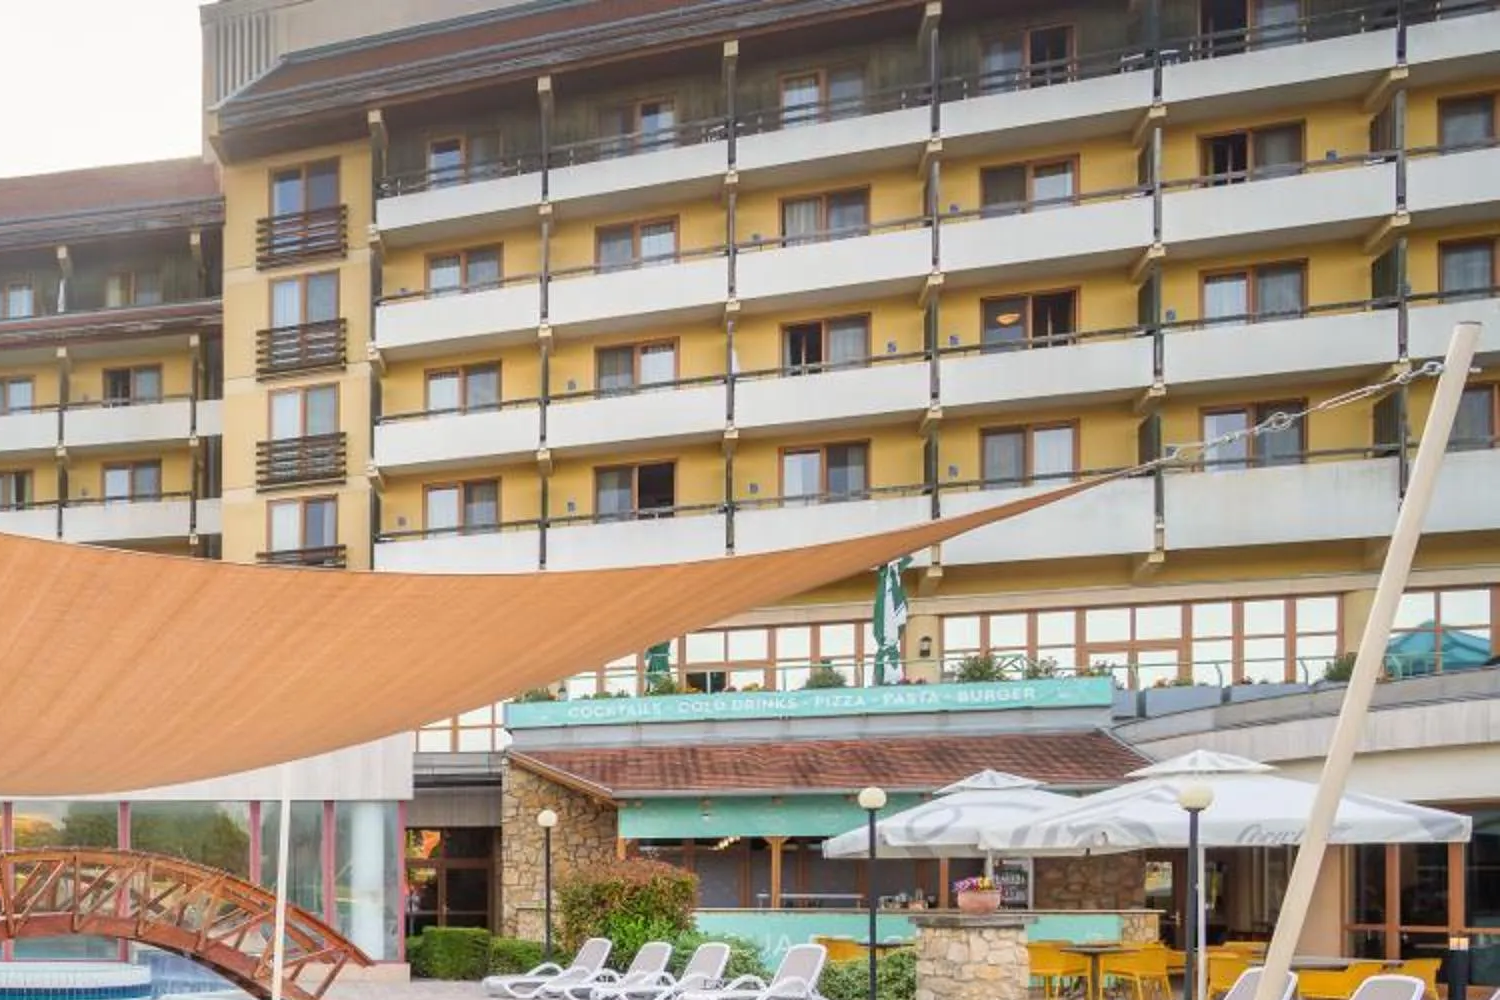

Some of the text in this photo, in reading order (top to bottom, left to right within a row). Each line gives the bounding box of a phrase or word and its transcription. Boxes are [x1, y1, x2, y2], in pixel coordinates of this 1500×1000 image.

[731, 697, 798, 711] DRINKS
[815, 694, 866, 708] PIZZA
[883, 690, 939, 705] PASTA
[957, 687, 1036, 703] BURGER
